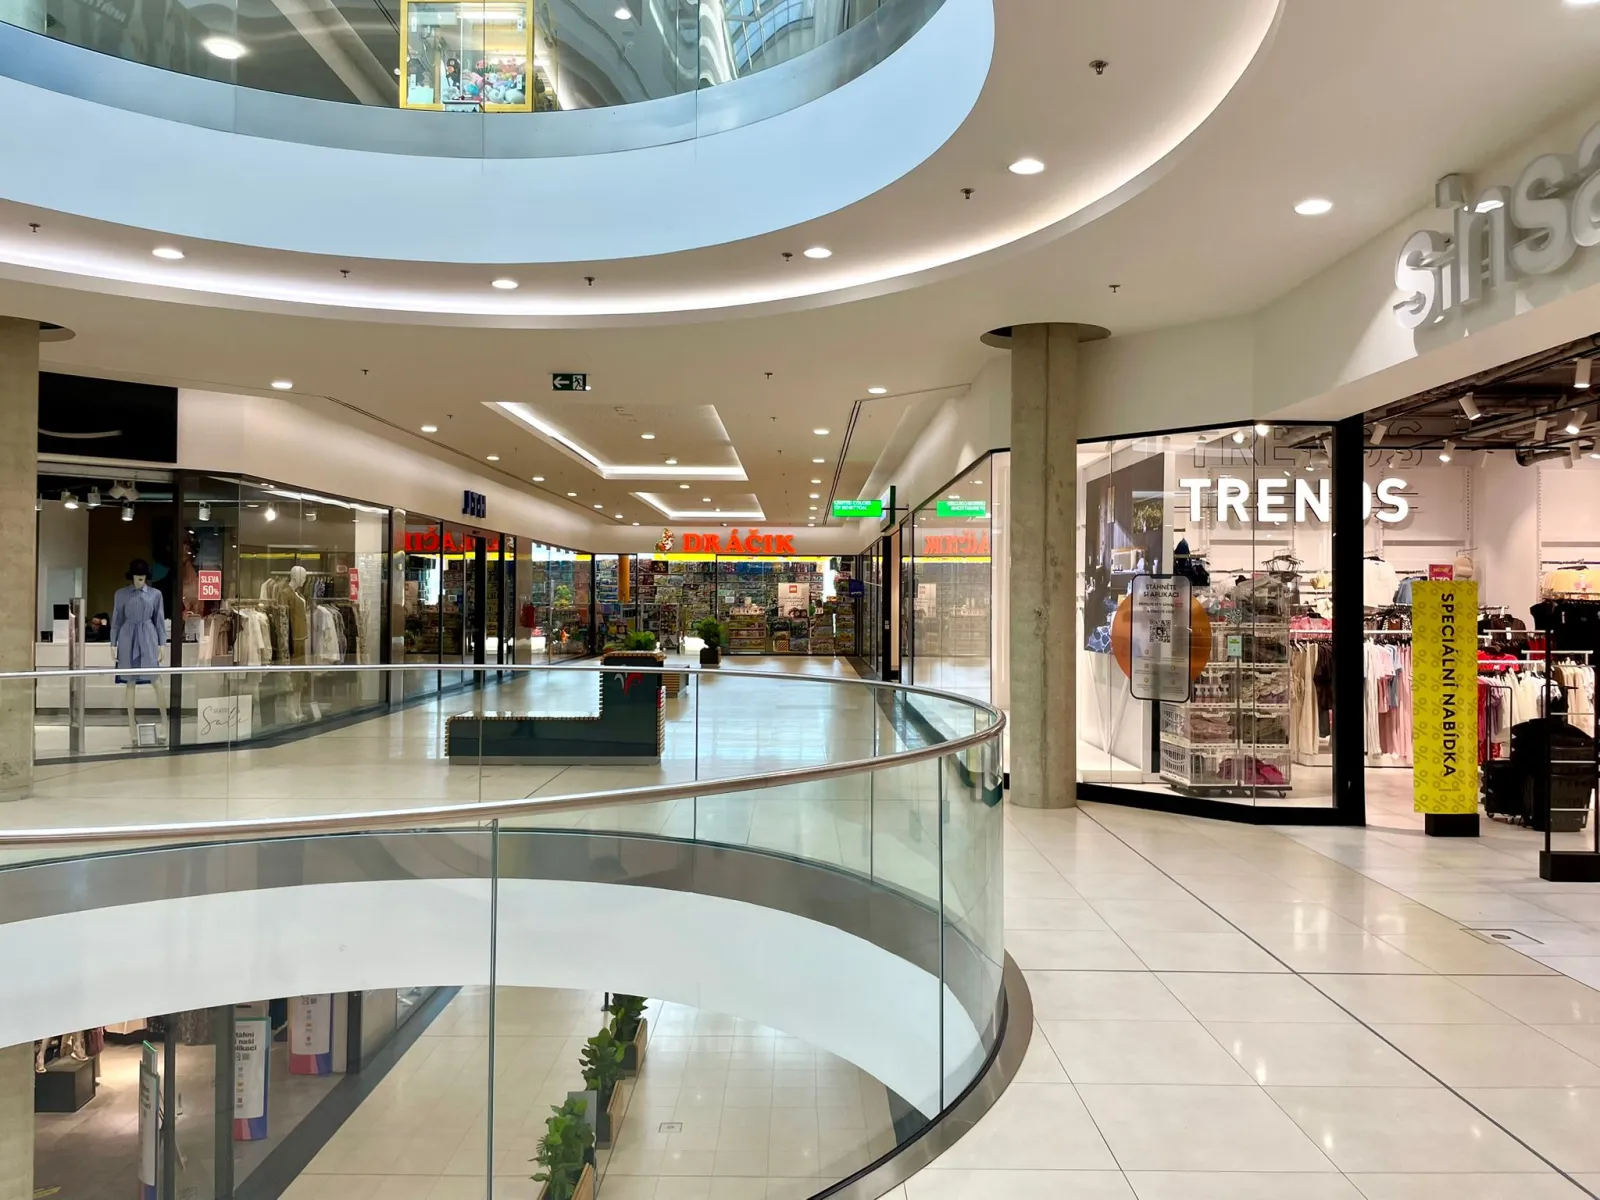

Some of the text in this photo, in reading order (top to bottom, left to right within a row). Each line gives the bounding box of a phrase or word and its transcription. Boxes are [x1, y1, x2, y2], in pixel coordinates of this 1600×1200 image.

[1179, 478, 1409, 522] TRENS
[682, 528, 797, 554] DRÁČIK
[201, 575, 220, 583] SLEVA
[202, 585, 219, 595] 50%
[1441, 593, 1459, 688] SPECIÁLNÍ
[1442, 693, 1459, 777] NABÍDKA
